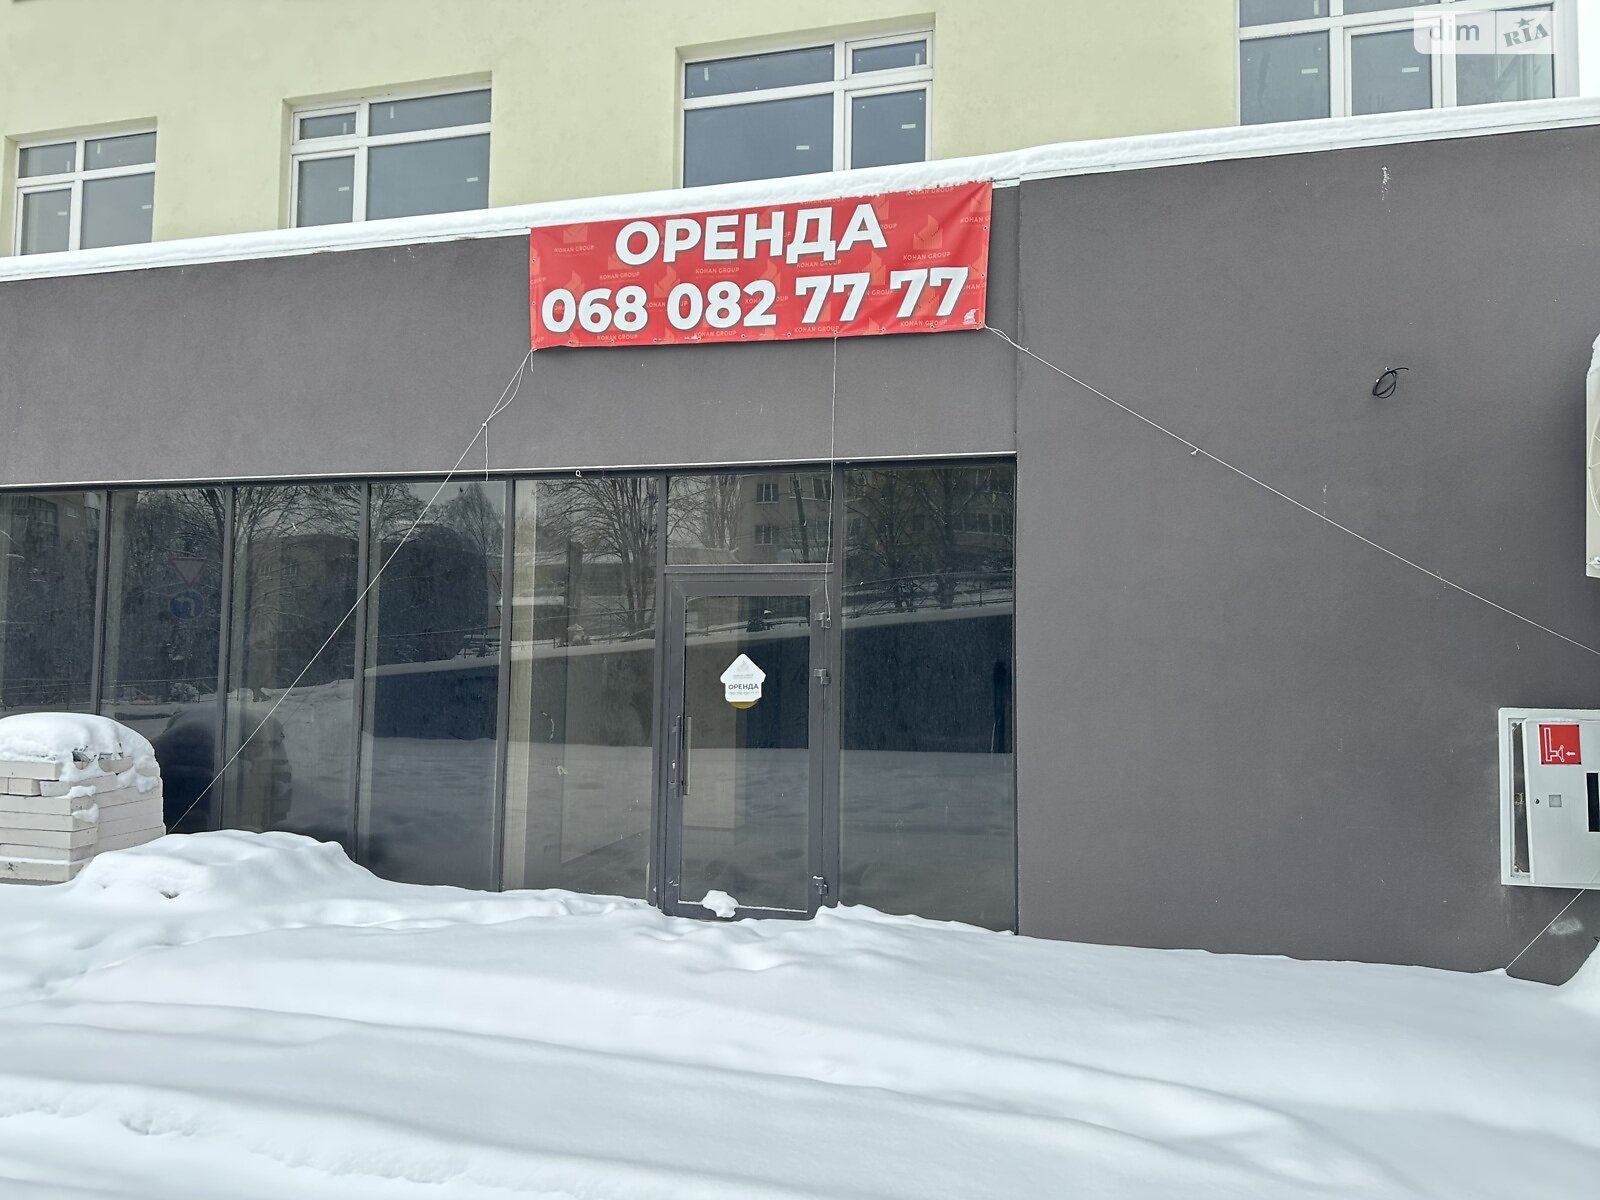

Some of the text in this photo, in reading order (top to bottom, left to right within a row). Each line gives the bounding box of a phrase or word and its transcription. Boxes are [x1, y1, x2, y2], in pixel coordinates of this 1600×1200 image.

[615, 203, 888, 266] ОРЕНДА
[928, 251, 951, 259] GROUP
[541, 266, 969, 333] 068 082 77 77
[900, 319, 923, 327] KOHAN
[728, 683, 759, 691] ОРЕНДА
